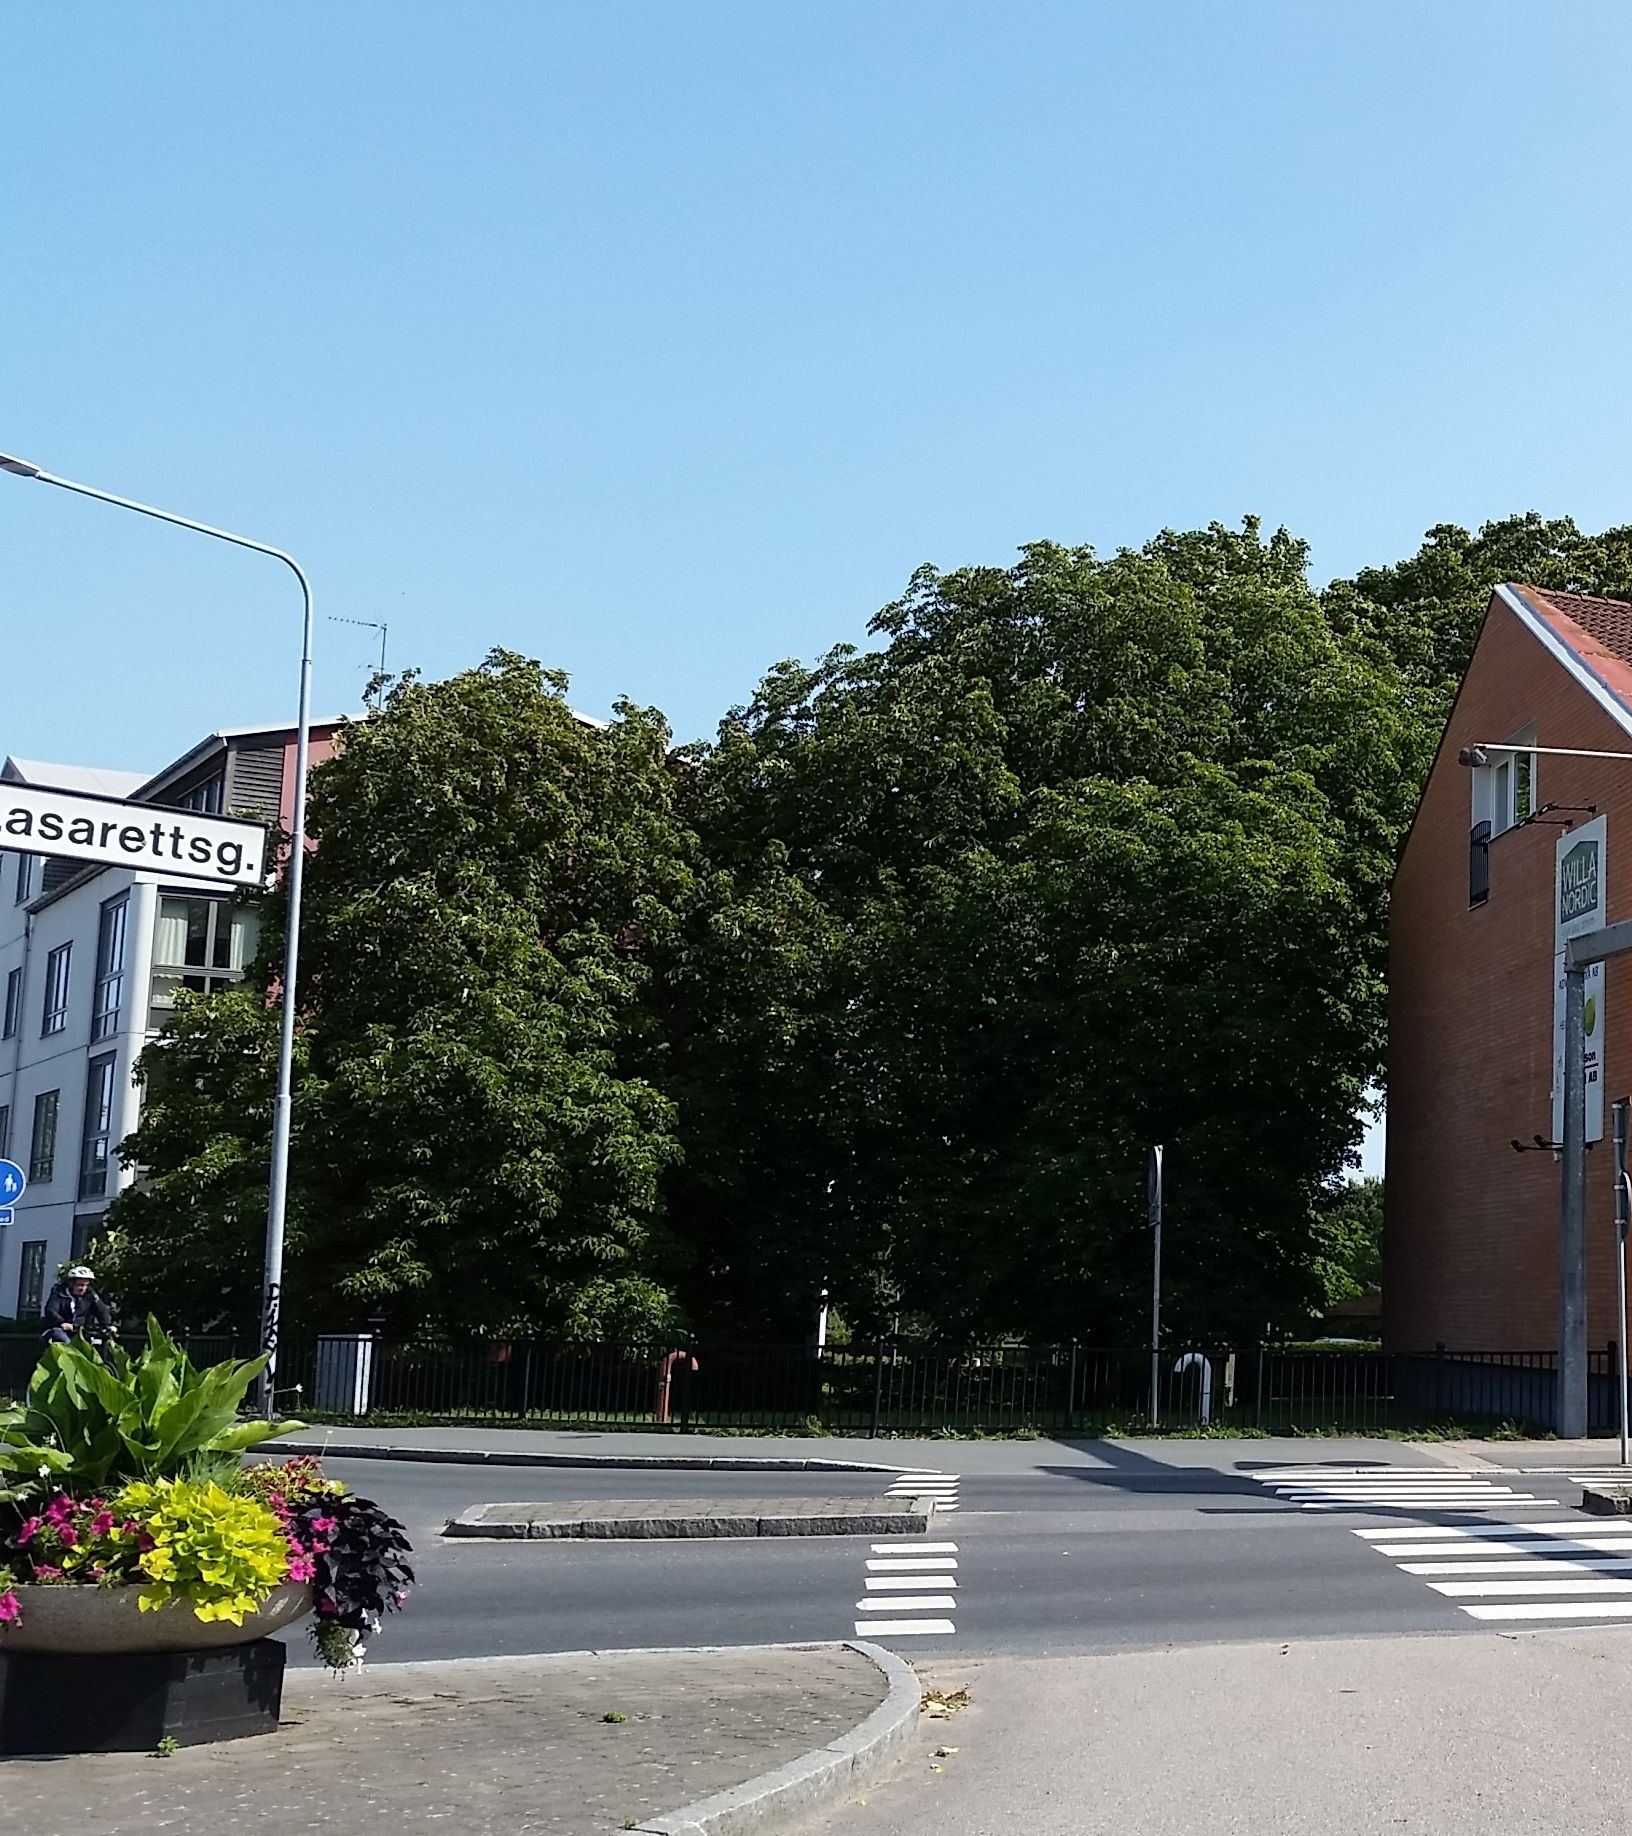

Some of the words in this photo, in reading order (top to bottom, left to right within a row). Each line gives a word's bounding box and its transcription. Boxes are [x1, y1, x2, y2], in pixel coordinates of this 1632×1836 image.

[0, 808, 254, 875] asarettsg.
[1562, 850, 1597, 892] WILLA
[1562, 880, 1597, 916] NORDIC
[1584, 1051, 1597, 1063] son
